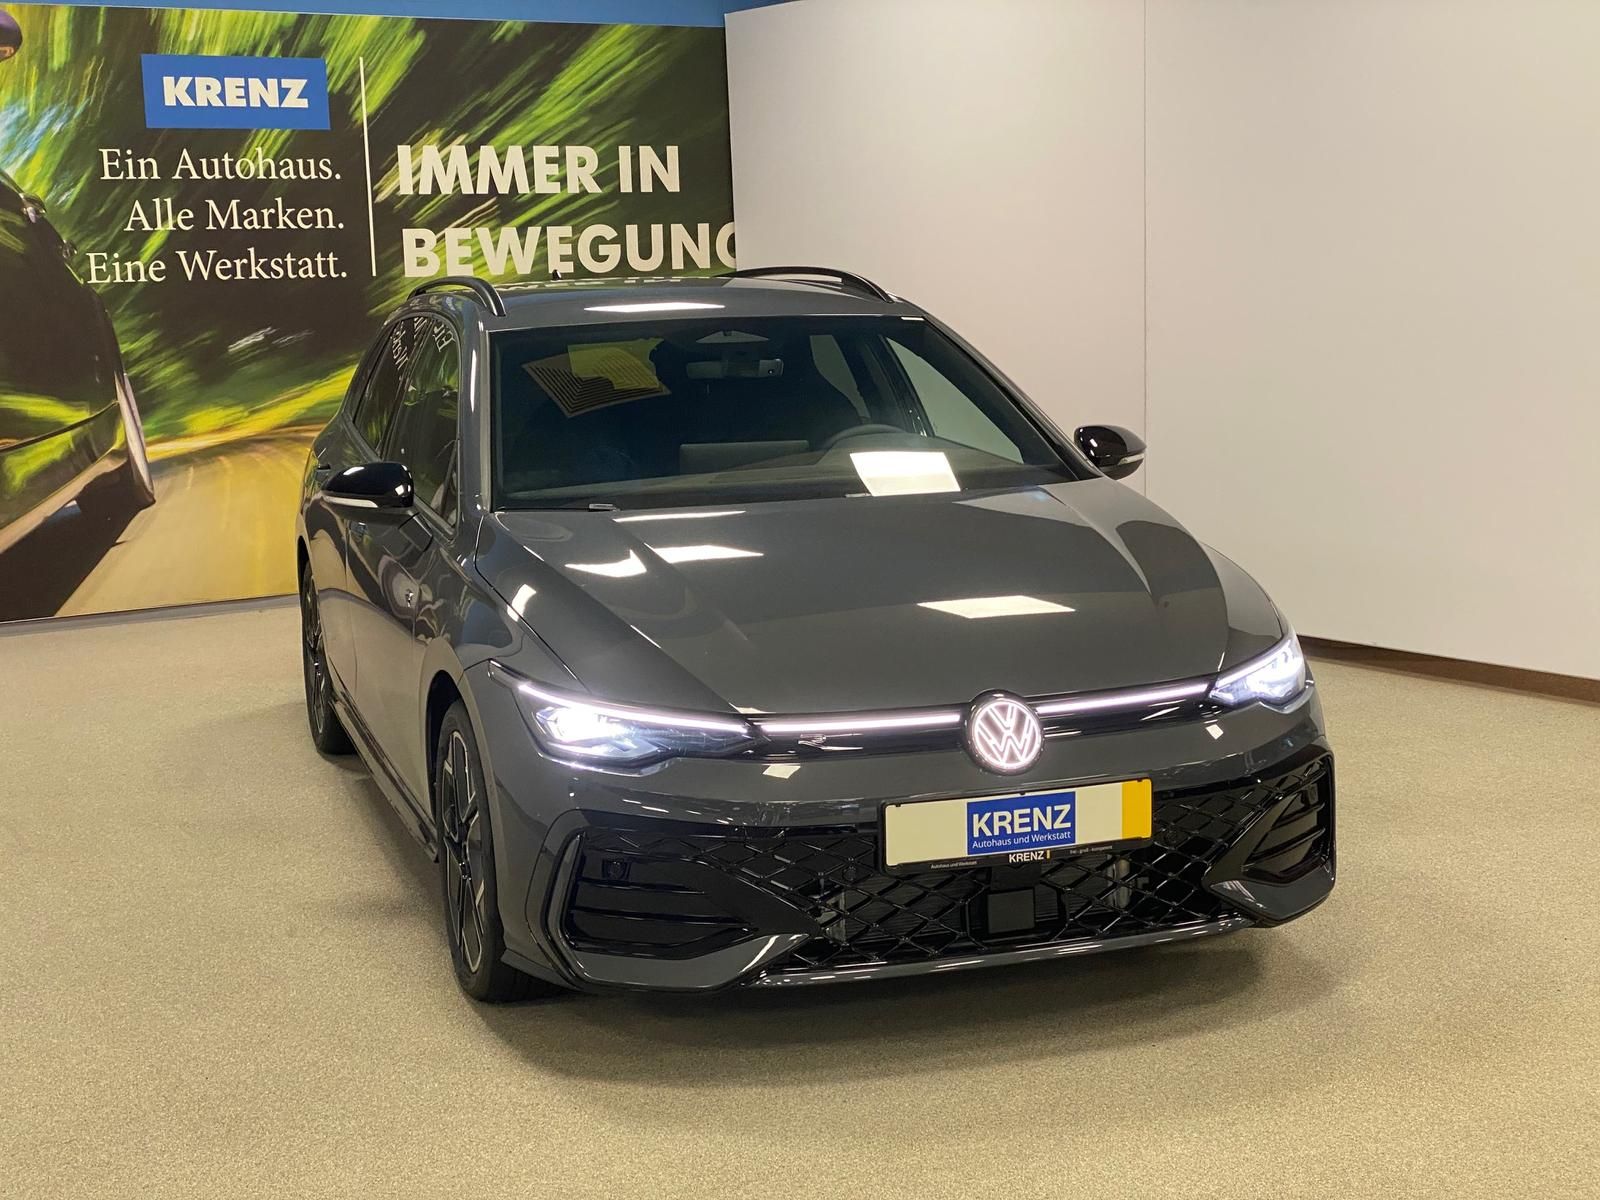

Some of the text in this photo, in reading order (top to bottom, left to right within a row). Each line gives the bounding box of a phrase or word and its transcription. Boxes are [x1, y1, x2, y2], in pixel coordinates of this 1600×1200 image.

[162, 76, 309, 109] KRENZ
[99, 146, 342, 181] Ein Autohaus.
[396, 144, 681, 195] IMMER IN
[123, 196, 345, 232] Alle Marken.
[85, 246, 348, 284] Eine Werkstatt.
[972, 803, 1072, 839] KRENZ
[972, 831, 1072, 849] Autohaus und Werkstatt
[1008, 850, 1045, 864] KRENZ
